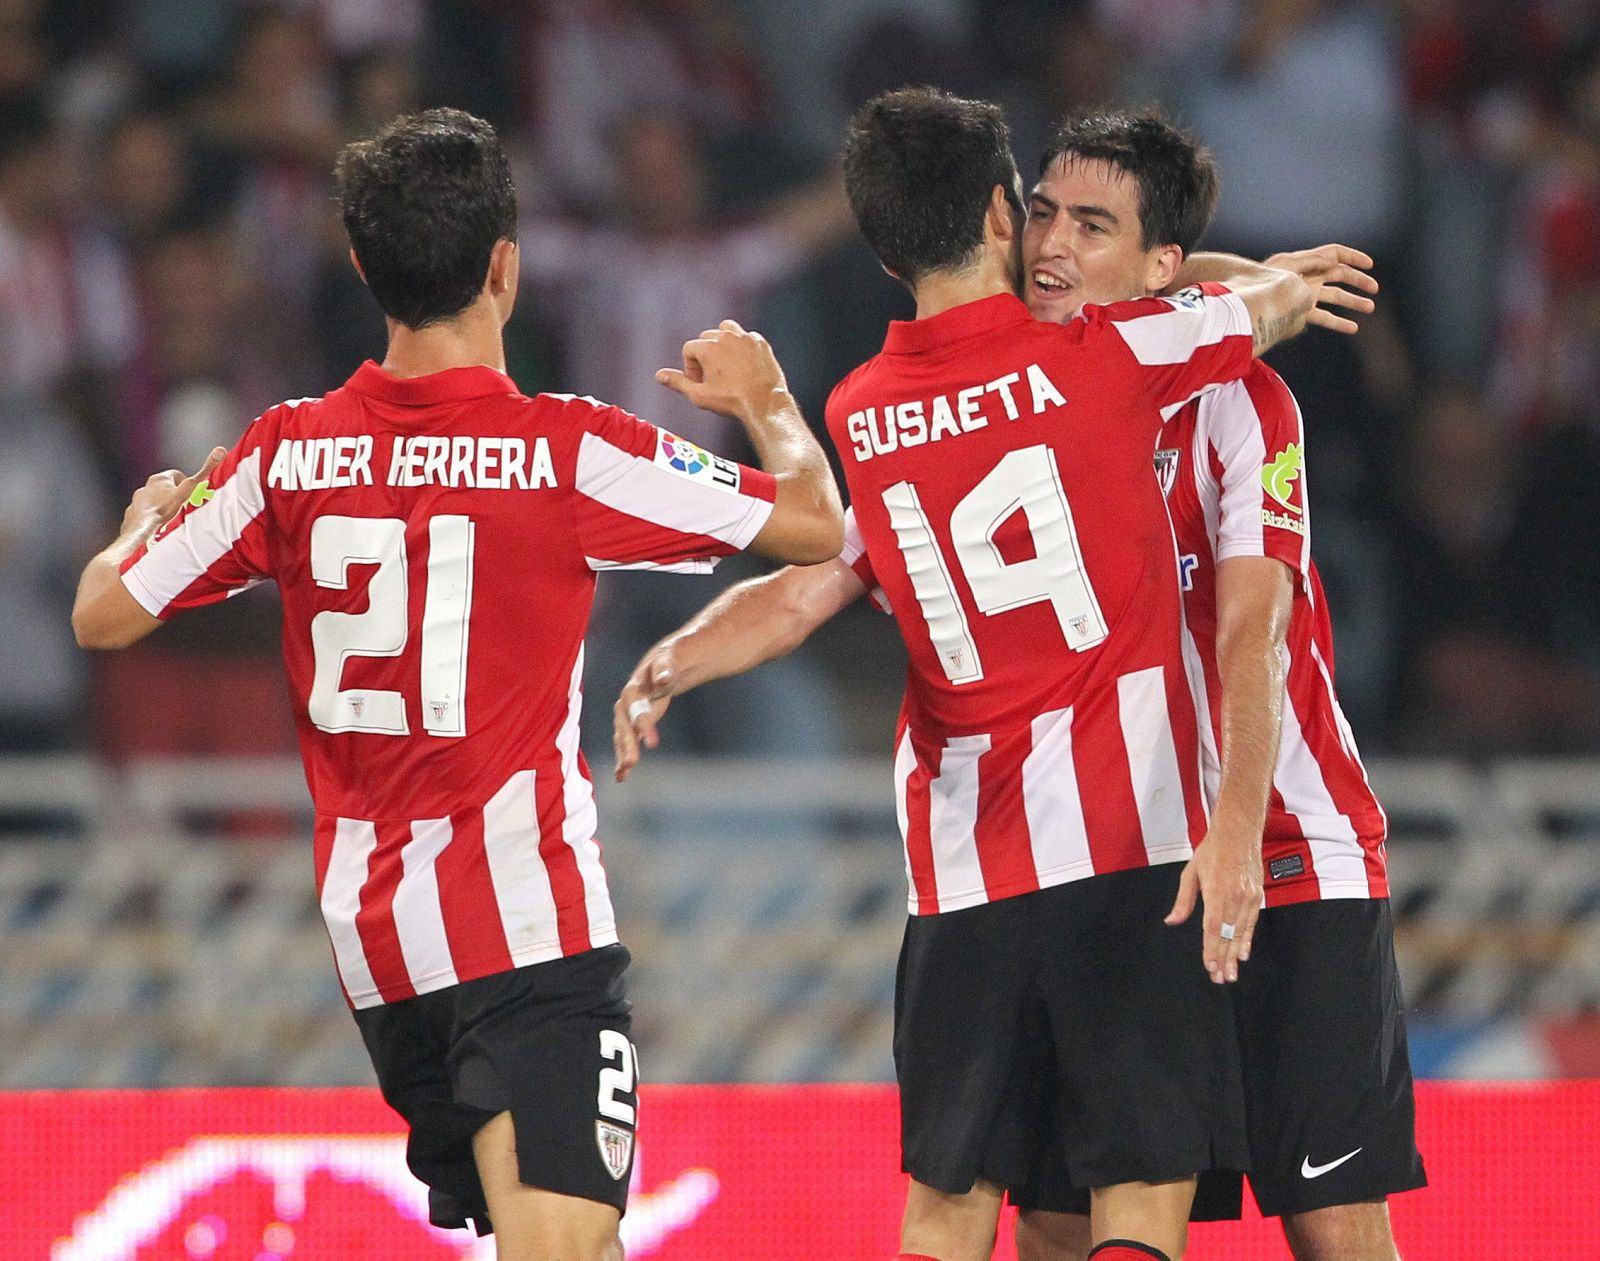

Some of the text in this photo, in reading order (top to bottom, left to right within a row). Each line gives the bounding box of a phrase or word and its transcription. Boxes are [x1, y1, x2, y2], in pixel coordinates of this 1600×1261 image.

[267, 435, 558, 491] ANDER HERRERA
[847, 364, 1067, 462] SUSAETA
[713, 455, 737, 488] LF
[881, 443, 1109, 686] 14
[309, 515, 476, 738] 21
[597, 1029, 640, 1131] 2
